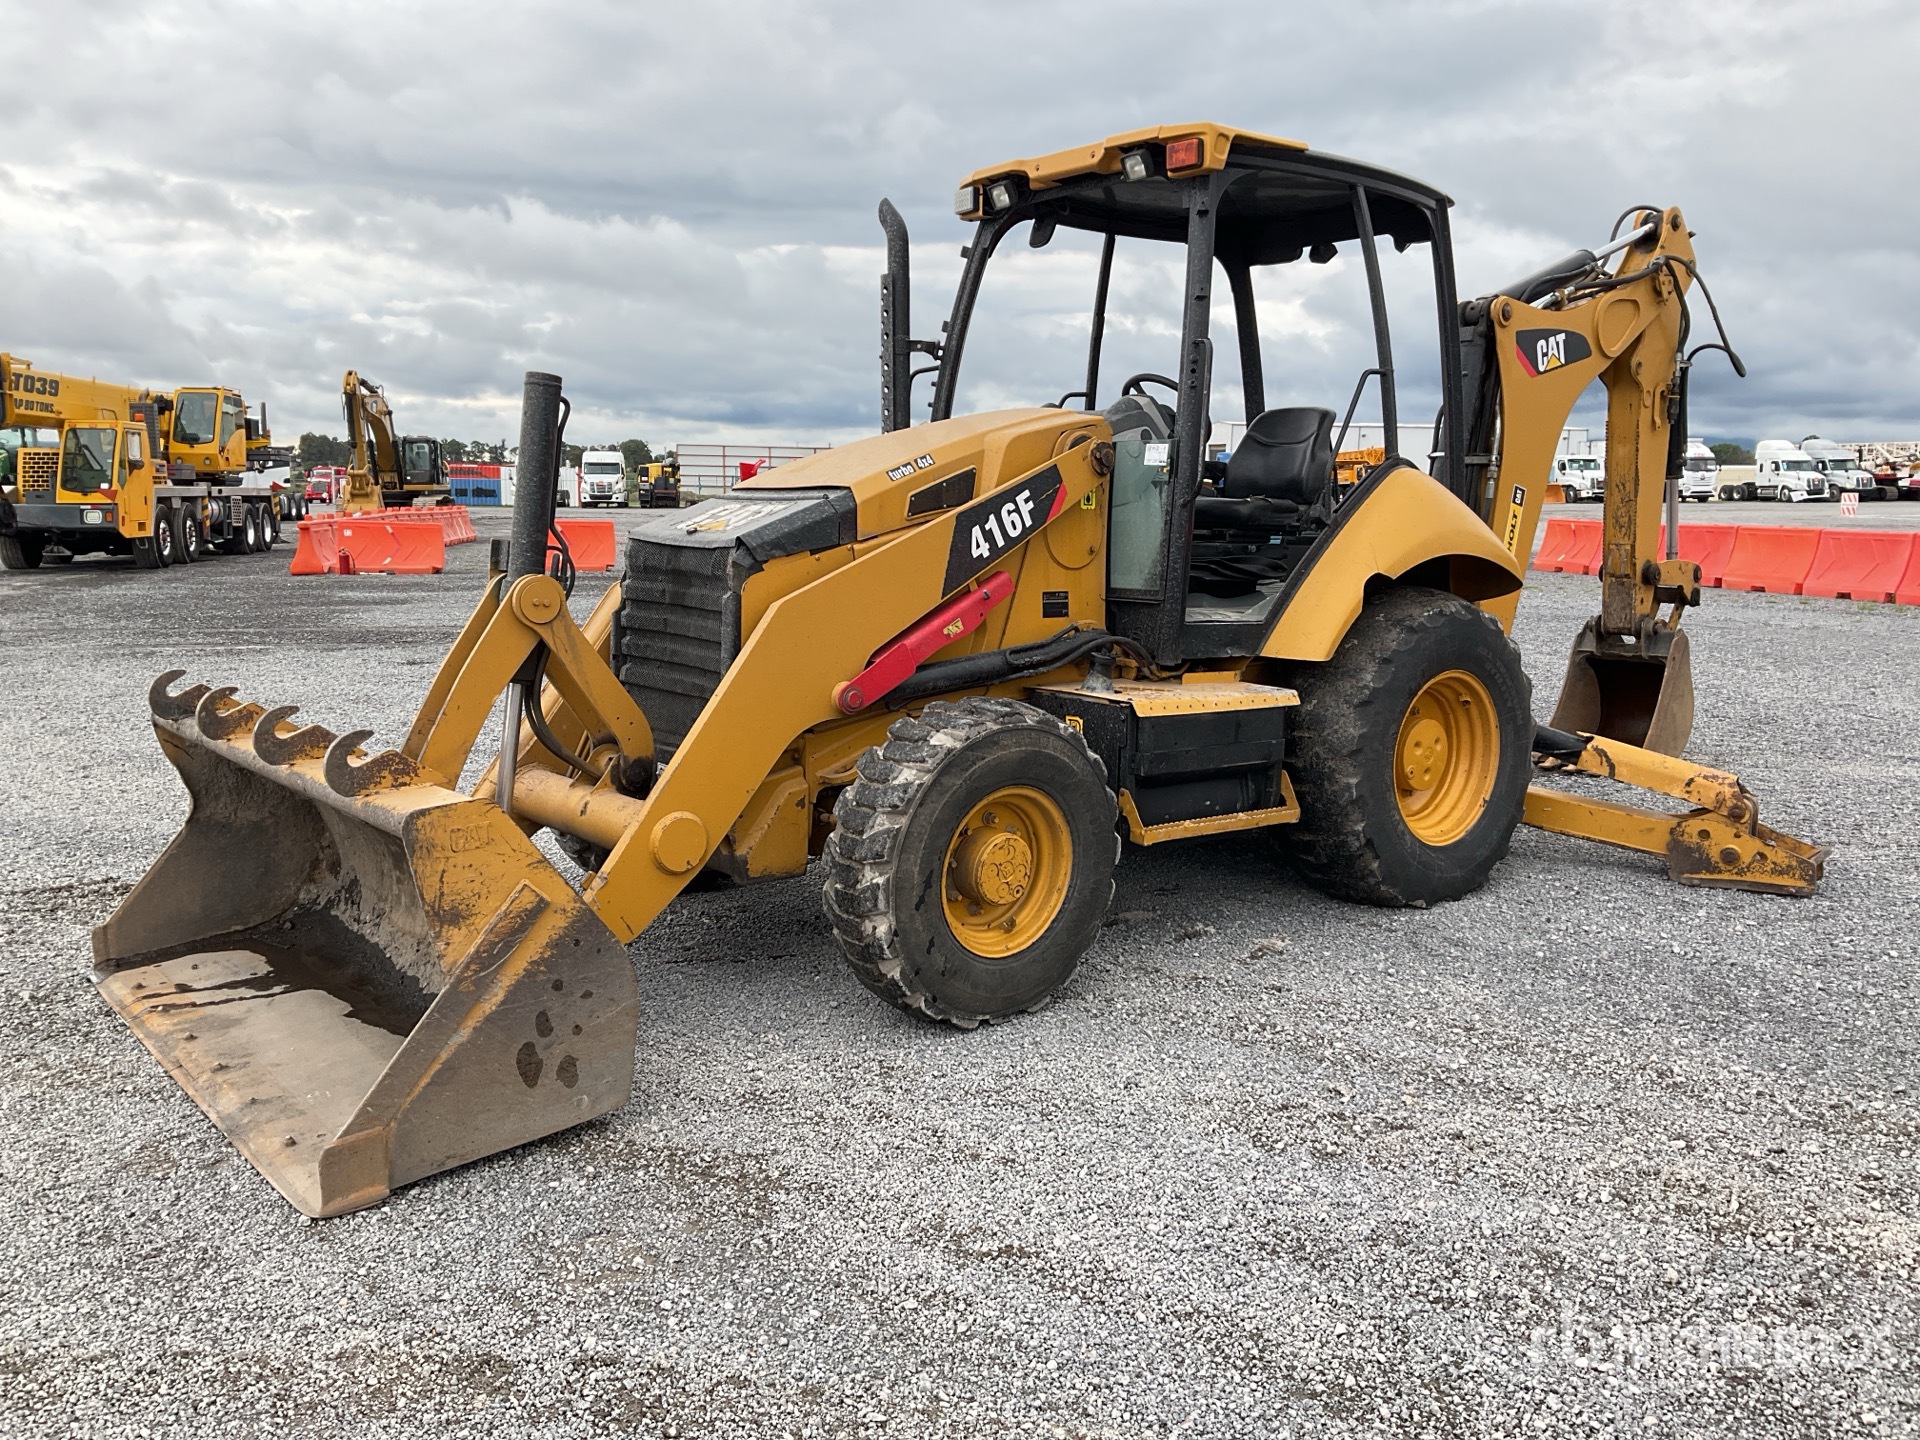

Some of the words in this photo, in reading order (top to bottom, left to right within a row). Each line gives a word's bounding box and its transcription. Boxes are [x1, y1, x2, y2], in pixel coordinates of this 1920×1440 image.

[1536, 332, 1566, 372] CAT
[24, 399, 35, 411] 80
[887, 464, 915, 481] turbo
[916, 453, 934, 469] 4x4
[970, 488, 1034, 559] 416F
[1507, 509, 1518, 553] HOLT
